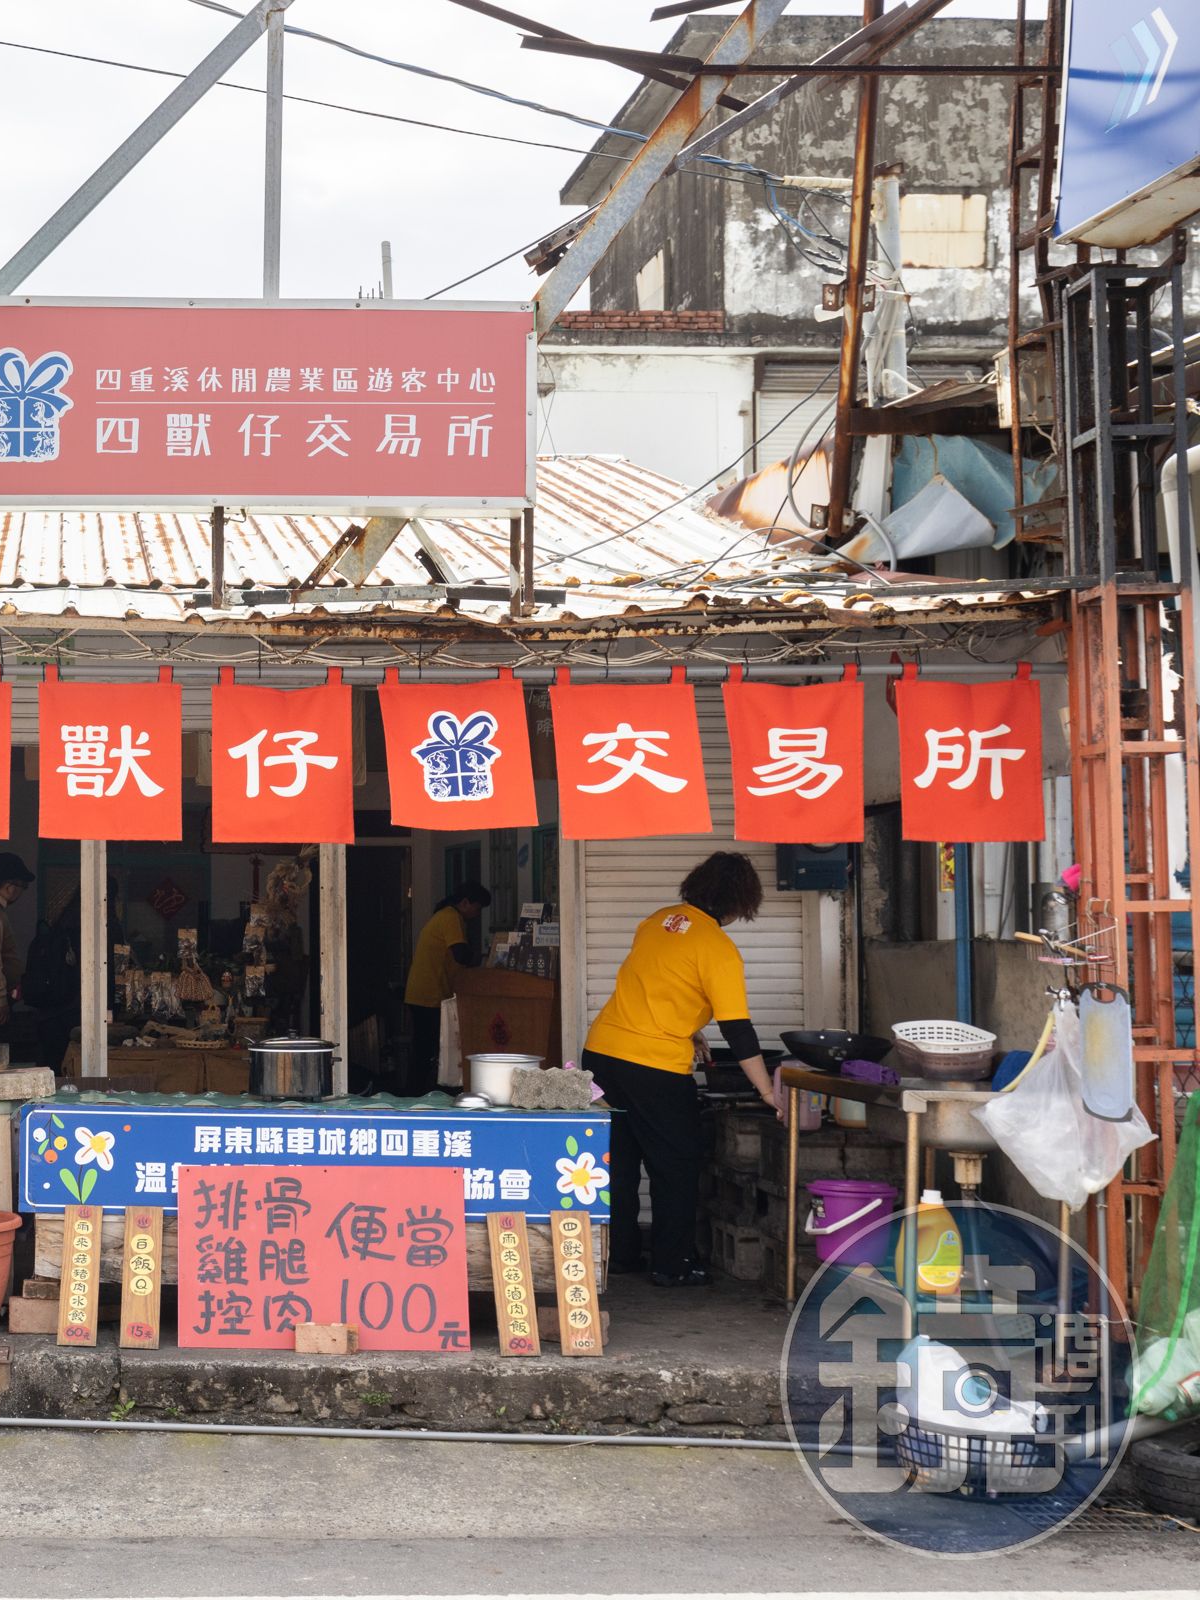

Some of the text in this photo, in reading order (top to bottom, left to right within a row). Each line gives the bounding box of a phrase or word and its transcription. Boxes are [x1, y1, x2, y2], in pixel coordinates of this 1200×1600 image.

[95, 366, 497, 394] 四重溪休閒農業區遊客中心
[95, 413, 494, 459] 四獸仔交易所
[193, 1125, 473, 1159] 屏東縣車城鄉四重溪
[194, 1176, 312, 1235] 排骨
[325, 1200, 455, 1269] 便當
[196, 1235, 311, 1286] 雞腿
[562, 1221, 589, 1325] 四獸仔煮物
[193, 1290, 313, 1336] 控肉
[338, 1278, 469, 1350] 100元
